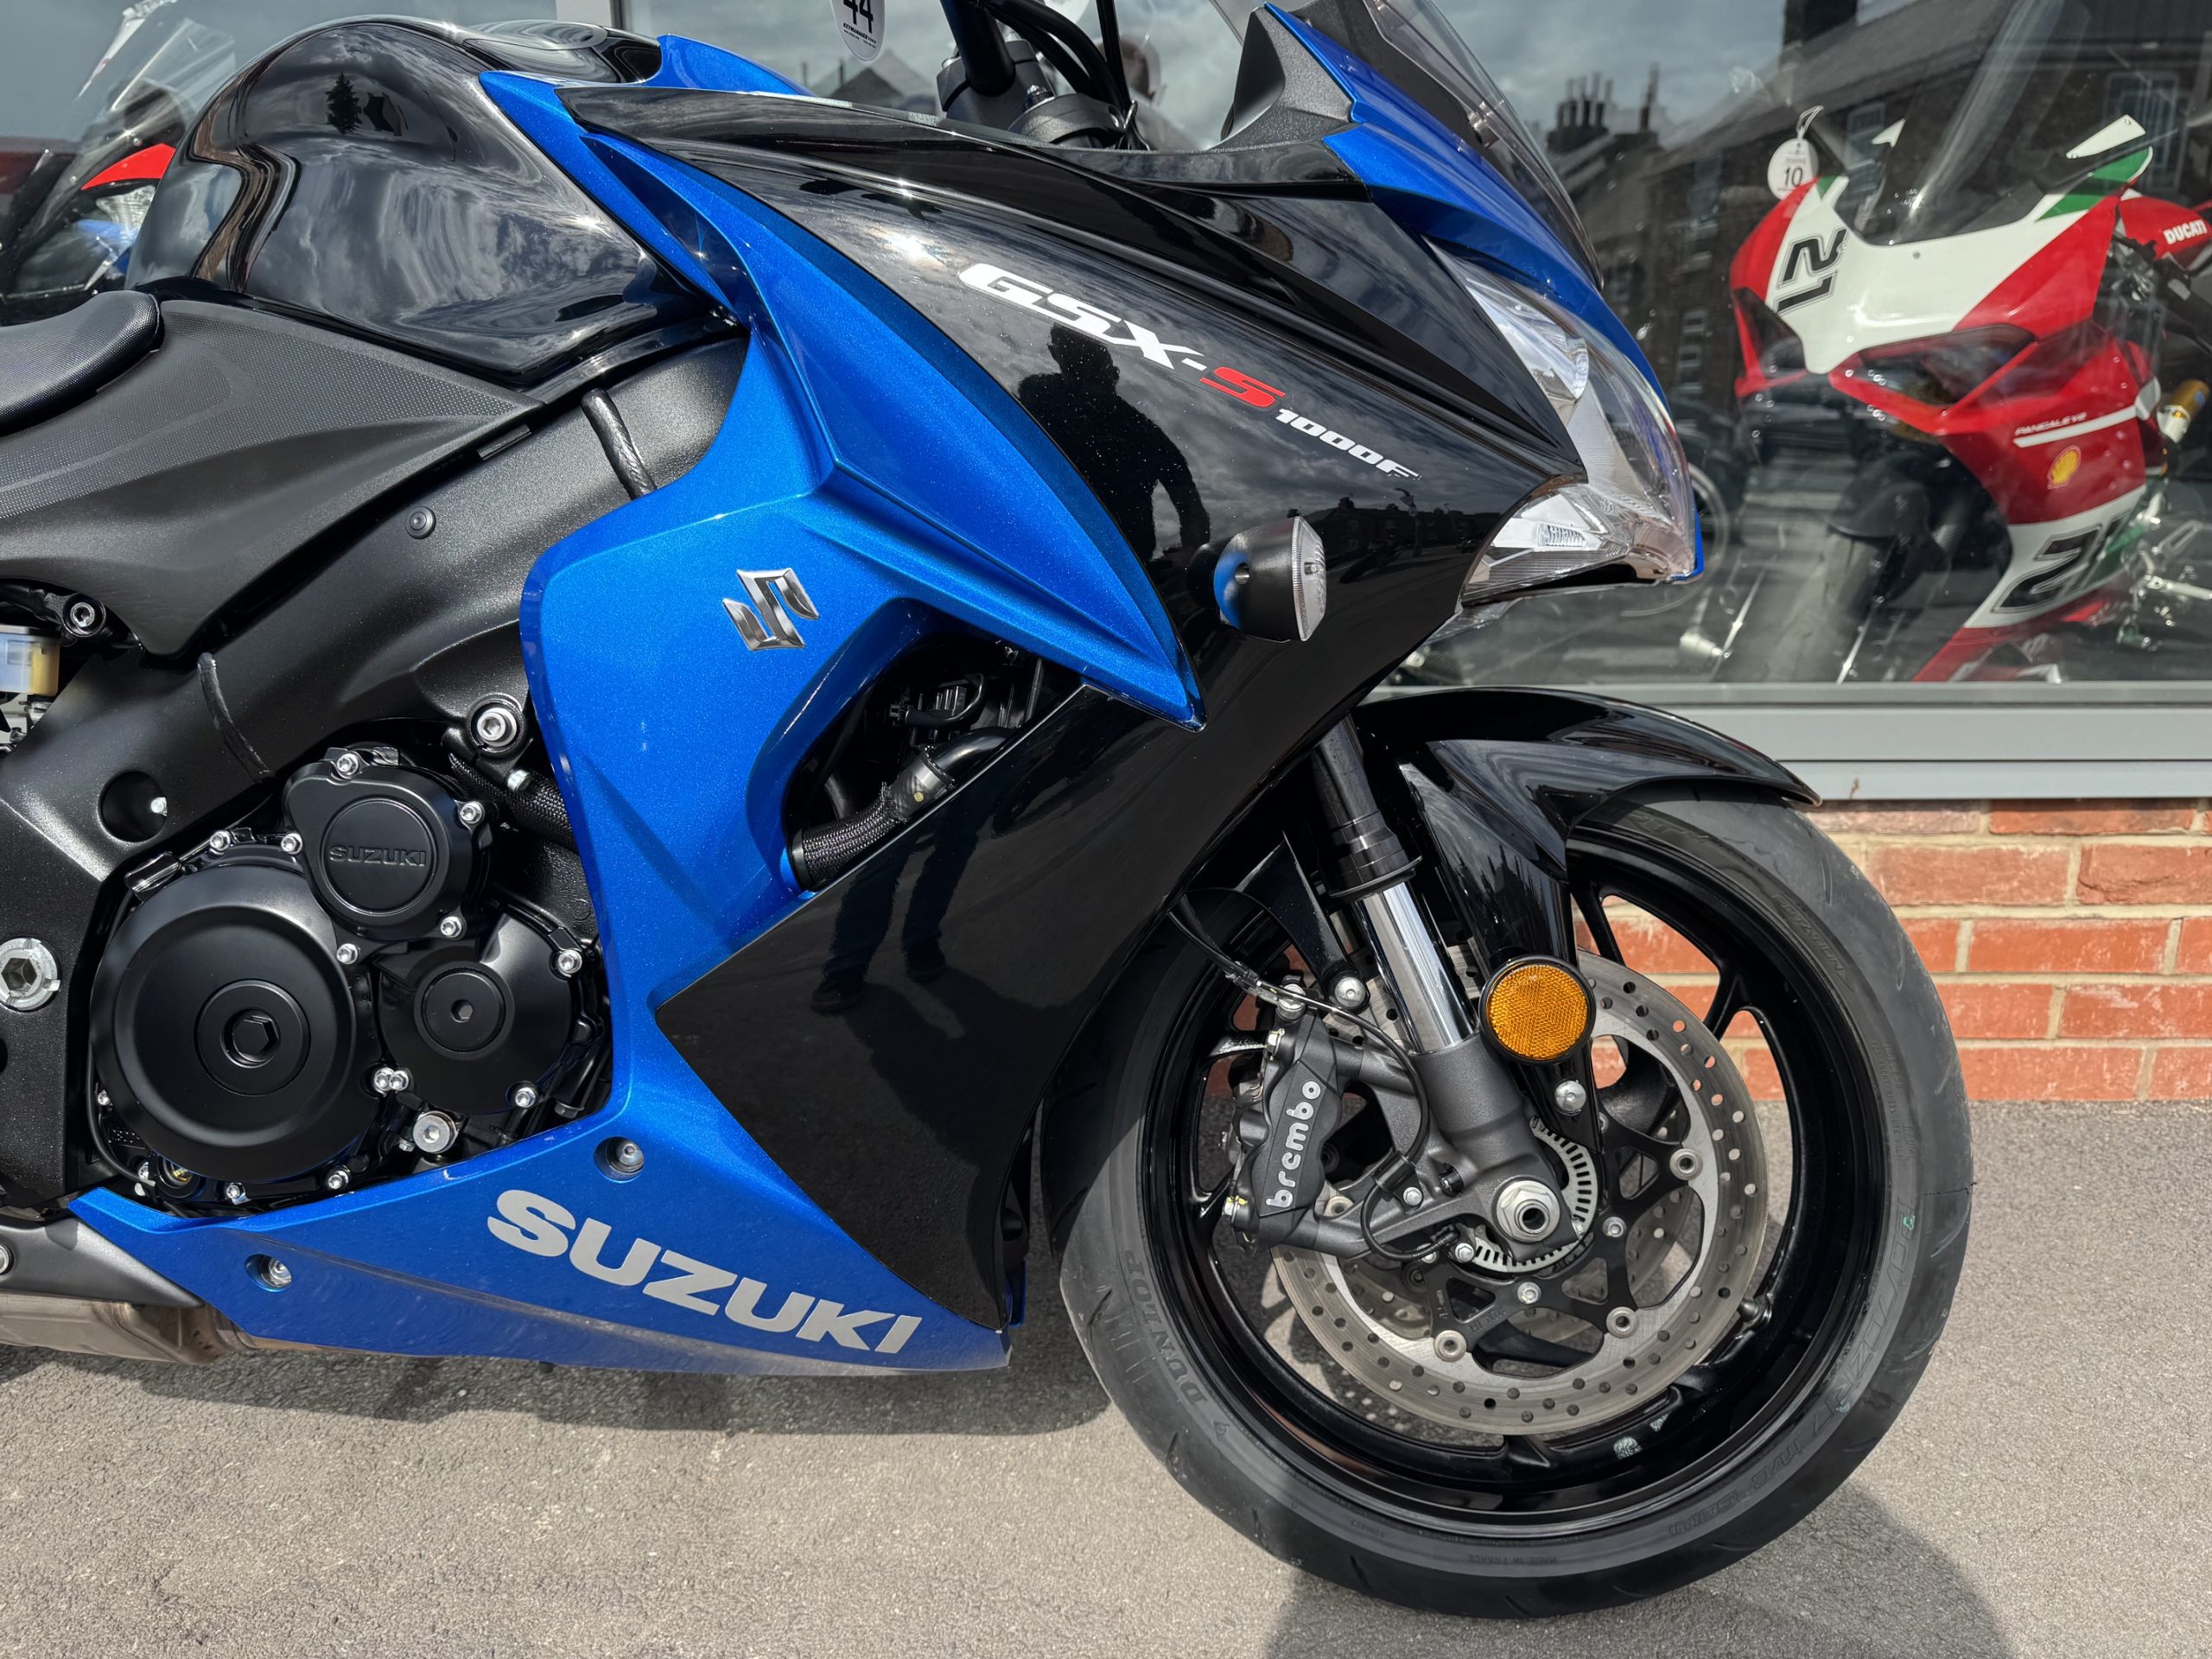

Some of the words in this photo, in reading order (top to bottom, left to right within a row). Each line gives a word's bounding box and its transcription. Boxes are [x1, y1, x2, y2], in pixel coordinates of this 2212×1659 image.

[1785, 167, 1803, 187] 10
[2163, 219, 2208, 245] DUCATI
[958, 263, 1286, 408] GSX-S
[1275, 407, 1423, 480] 1000F
[328, 846, 426, 867] SUZUKI
[1265, 1080, 1321, 1209] brembo
[487, 1189, 922, 1354] SUZUKI
[1125, 1249, 1207, 1406] DUNLOP
